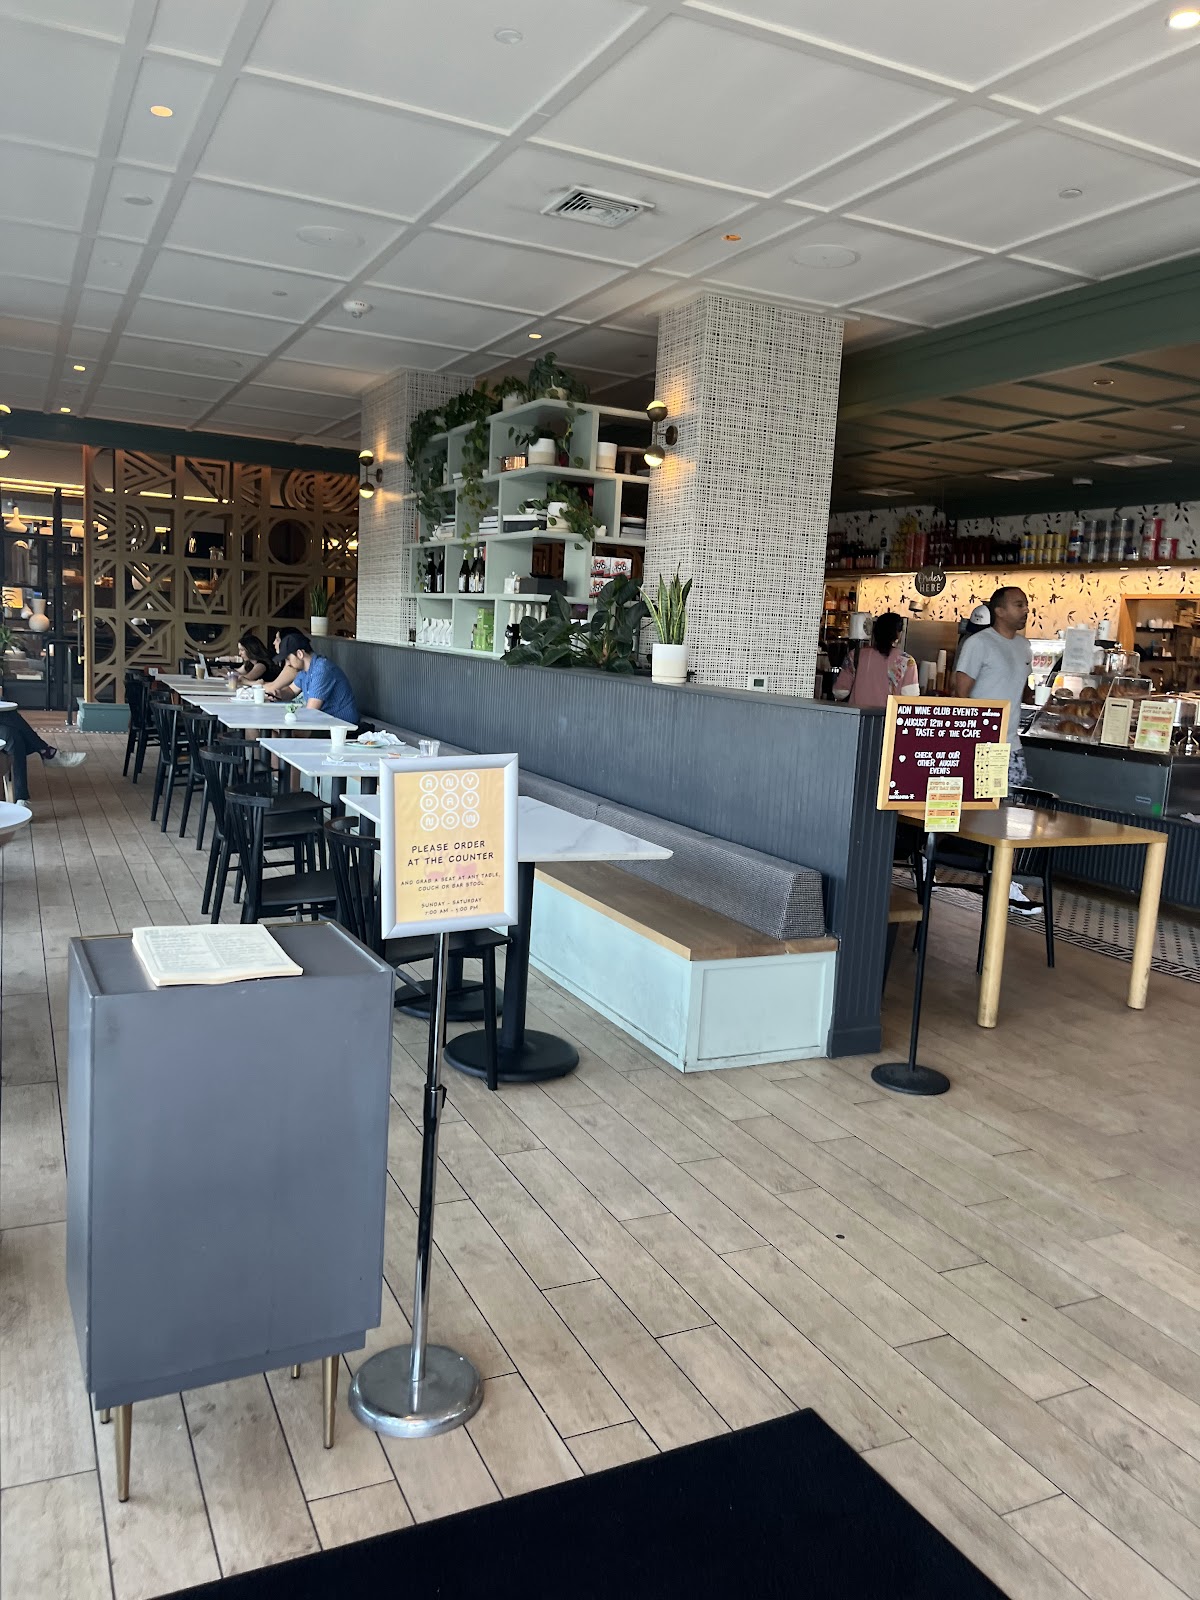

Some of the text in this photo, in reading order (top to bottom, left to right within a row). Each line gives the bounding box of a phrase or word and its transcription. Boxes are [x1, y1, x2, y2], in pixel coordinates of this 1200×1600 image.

[918, 571, 943, 583] Order
[920, 583, 941, 592] HERE
[898, 705, 979, 717] ADN WINE CLUB EVENTS
[904, 718, 928, 727] AUGUST
[929, 718, 943, 728] 12TH
[967, 719, 977, 728] PM
[915, 727, 936, 737] TASTE
[938, 729, 947, 737] OF
[949, 730, 960, 738] THE
[914, 750, 961, 759] CHECK OUT OUR
[917, 758, 960, 767] OTHER AUGUST
[929, 767, 951, 775] EVENTS
[425, 774, 475, 789] ANY
[425, 794, 475, 809] DAY
[425, 813, 476, 828] NOW
[411, 840, 486, 854] PLEASE ORDER
[407, 852, 494, 867] AT THE COUNTER
[421, 901, 445, 909] SUNDAY
[452, 897, 482, 905] SATURDAY
